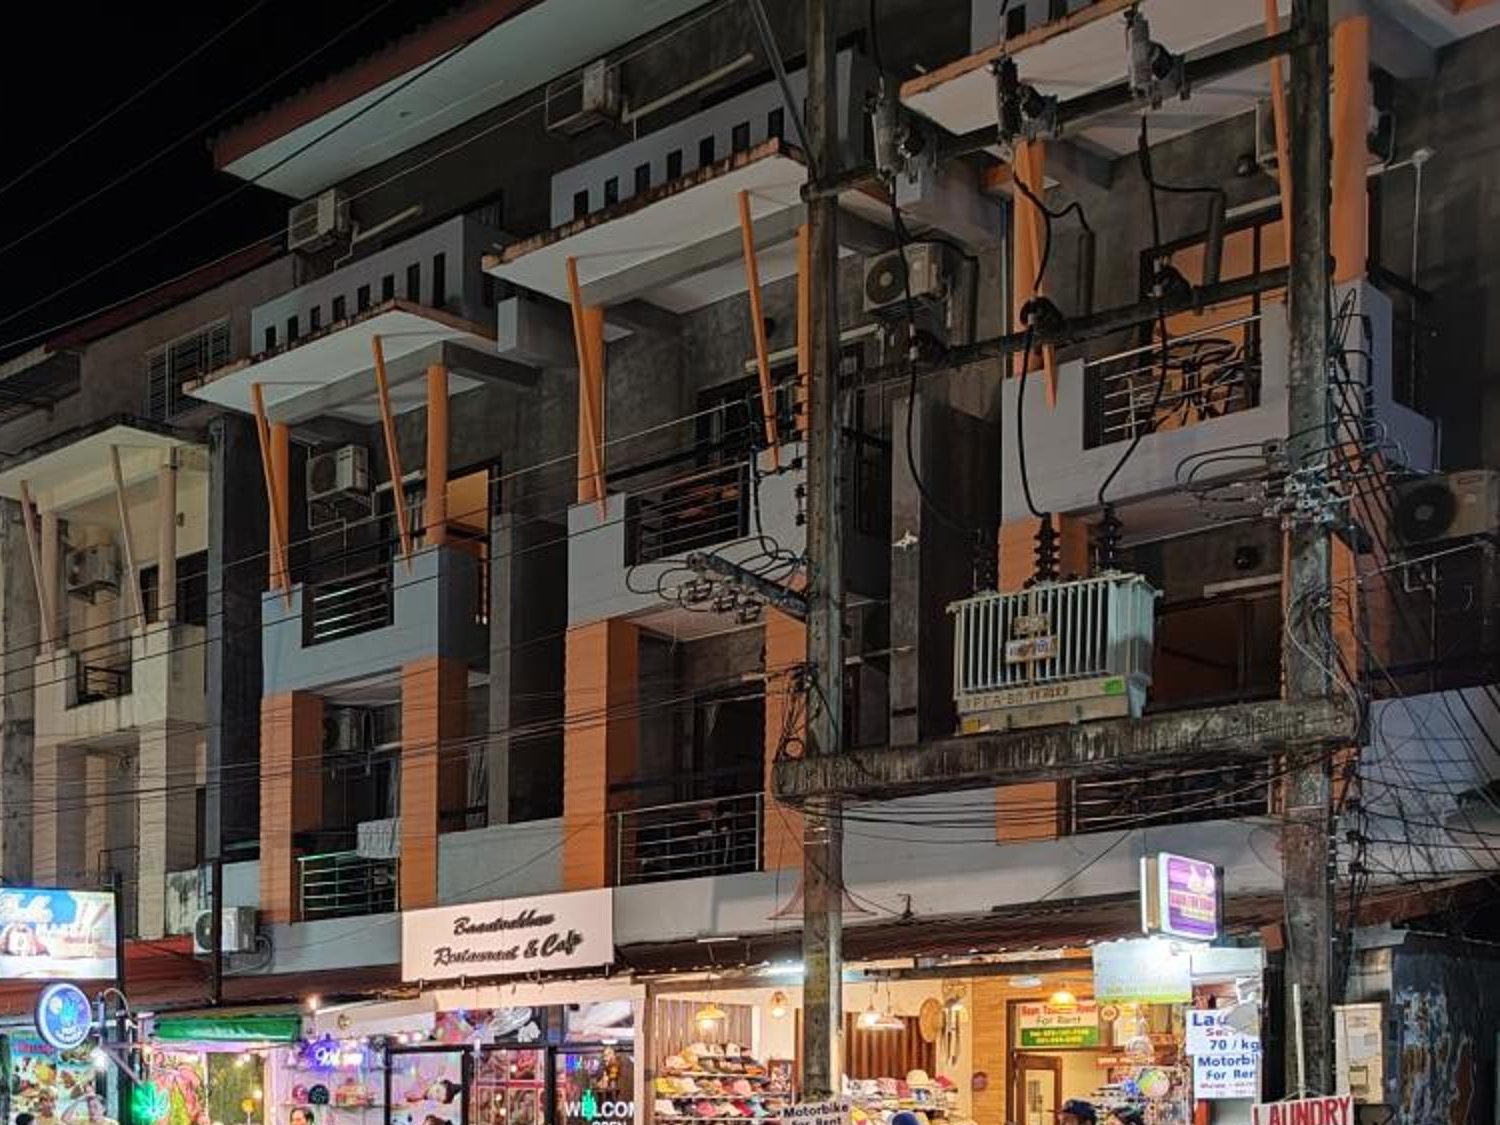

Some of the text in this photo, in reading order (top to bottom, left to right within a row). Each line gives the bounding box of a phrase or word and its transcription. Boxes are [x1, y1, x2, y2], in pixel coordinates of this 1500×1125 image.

[523, 939, 540, 958] &
[1210, 1039, 1227, 1051] 70
[783, 1102, 849, 1118] Motorbike
